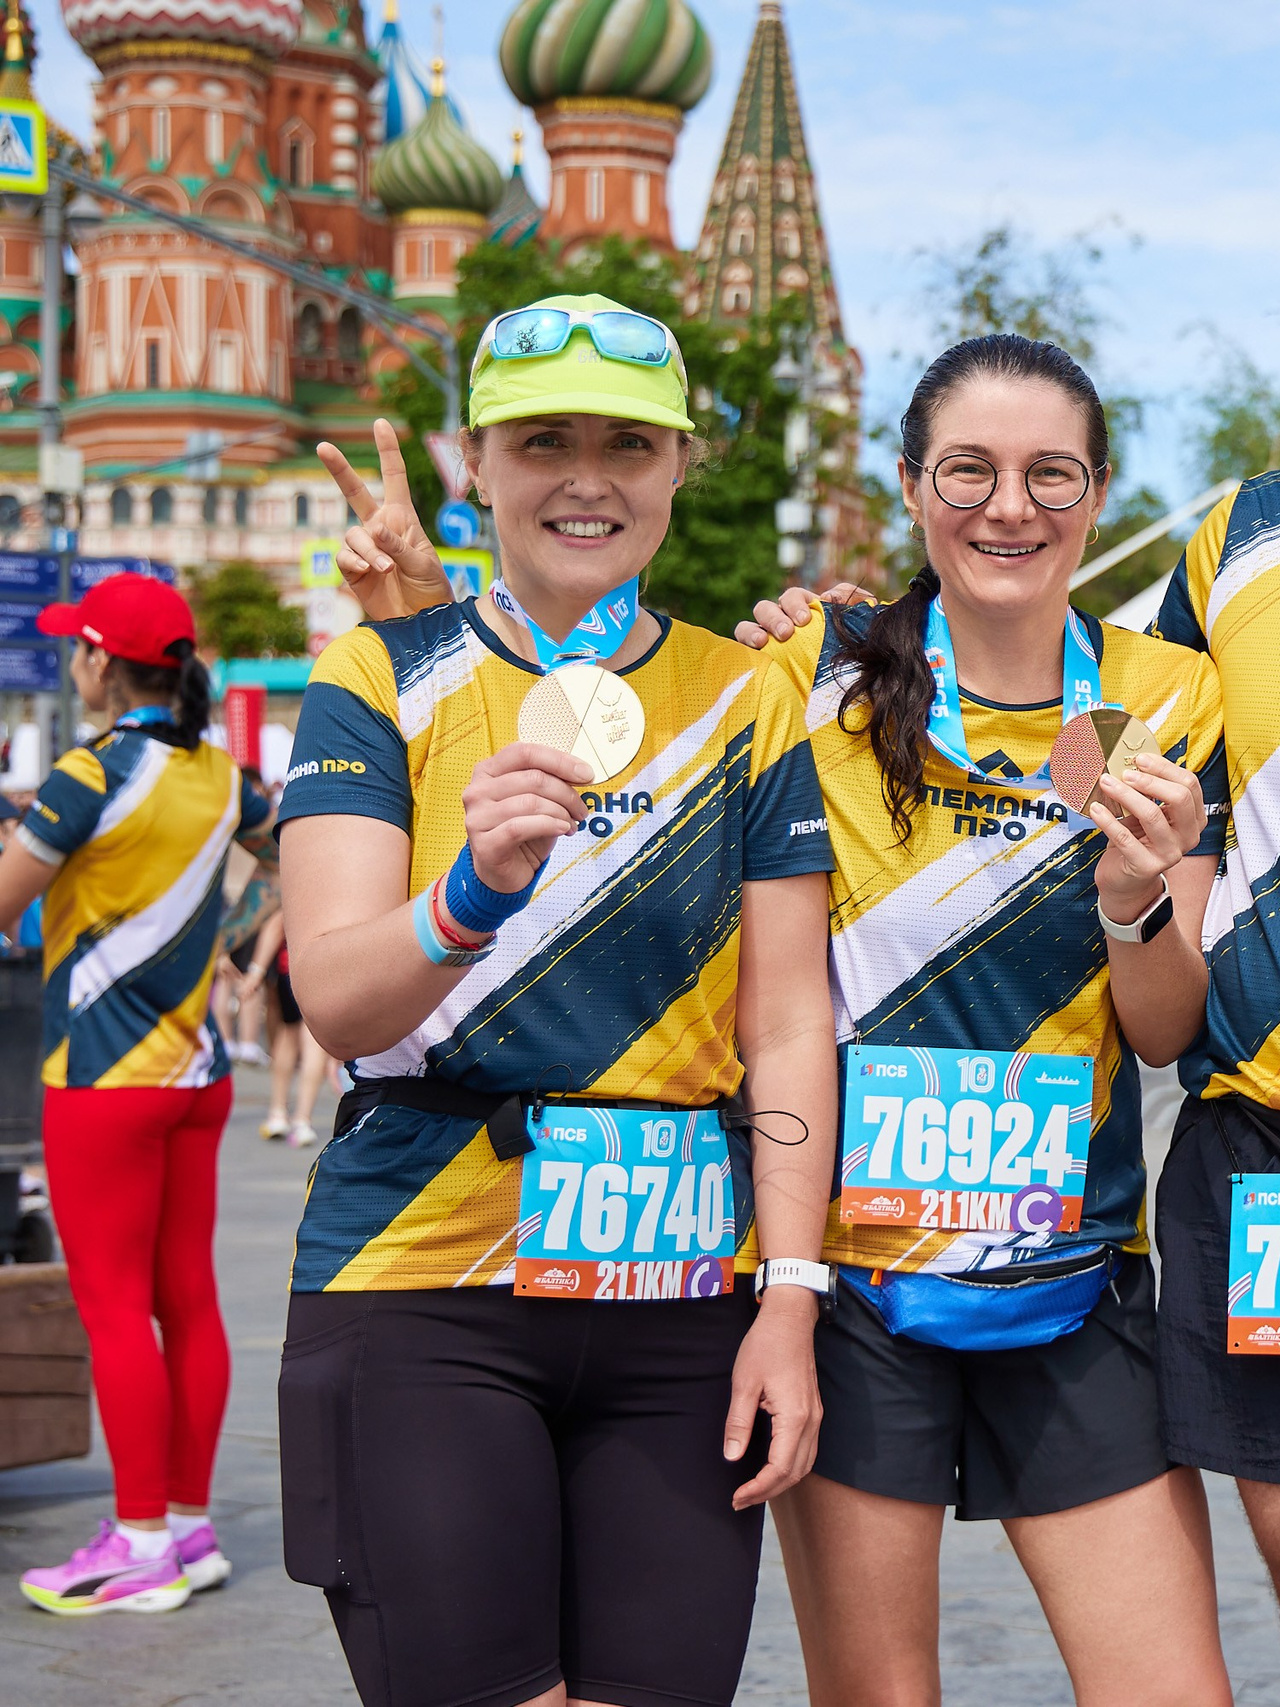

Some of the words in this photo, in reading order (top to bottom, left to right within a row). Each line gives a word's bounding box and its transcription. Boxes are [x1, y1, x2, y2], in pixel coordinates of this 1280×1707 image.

[577, 350, 603, 363] GR
[322, 759, 367, 775] ПРО
[579, 790, 654, 814] АНА
[920, 784, 1069, 824] ЛЕМАНА
[953, 813, 1027, 842] ПРО
[876, 1063, 908, 1079] ПСБ
[956, 1056, 996, 1093] 10
[552, 1127, 588, 1142] ПСБ
[640, 1119, 677, 1158] 10
[862, 1095, 1073, 1188] 76924
[539, 1160, 724, 1254] 76740
[918, 1188, 1013, 1230] 21.1KM
[1017, 1191, 1053, 1232] C
[594, 1259, 684, 1300] 21.1KM
[690, 1261, 720, 1298] C
